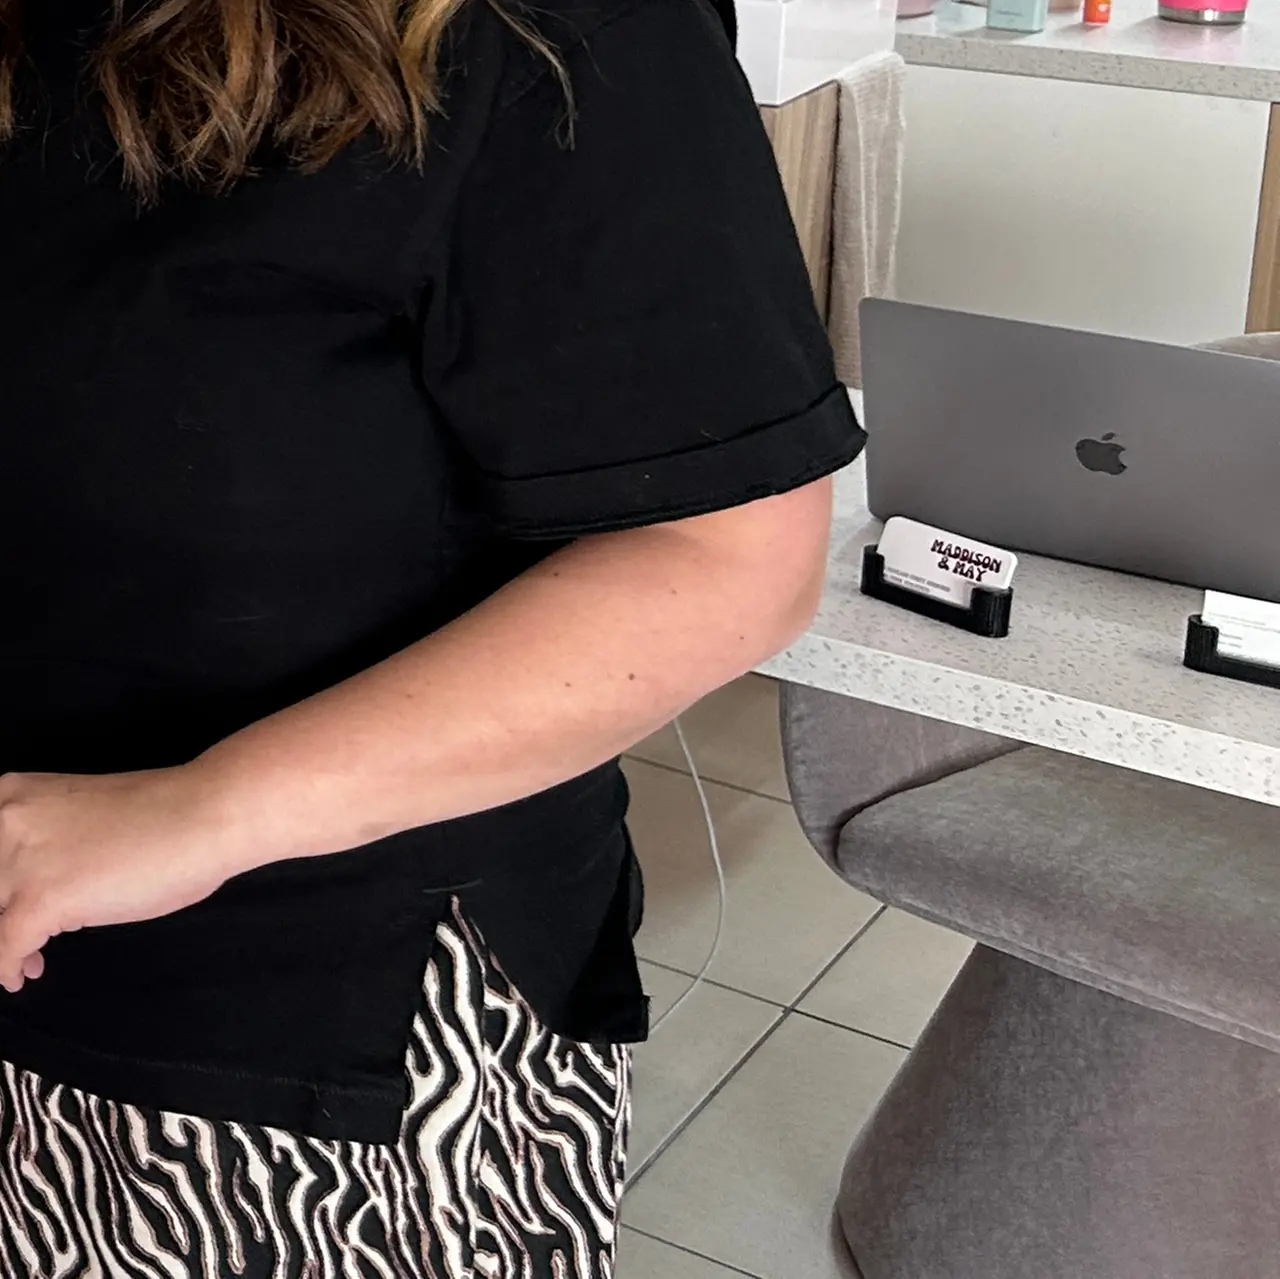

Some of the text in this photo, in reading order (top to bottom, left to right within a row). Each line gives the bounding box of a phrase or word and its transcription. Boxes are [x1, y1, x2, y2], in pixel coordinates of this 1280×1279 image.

[930, 539, 1002, 574] MADDISON
[937, 556, 950, 571] &
[952, 561, 987, 582] MAY
